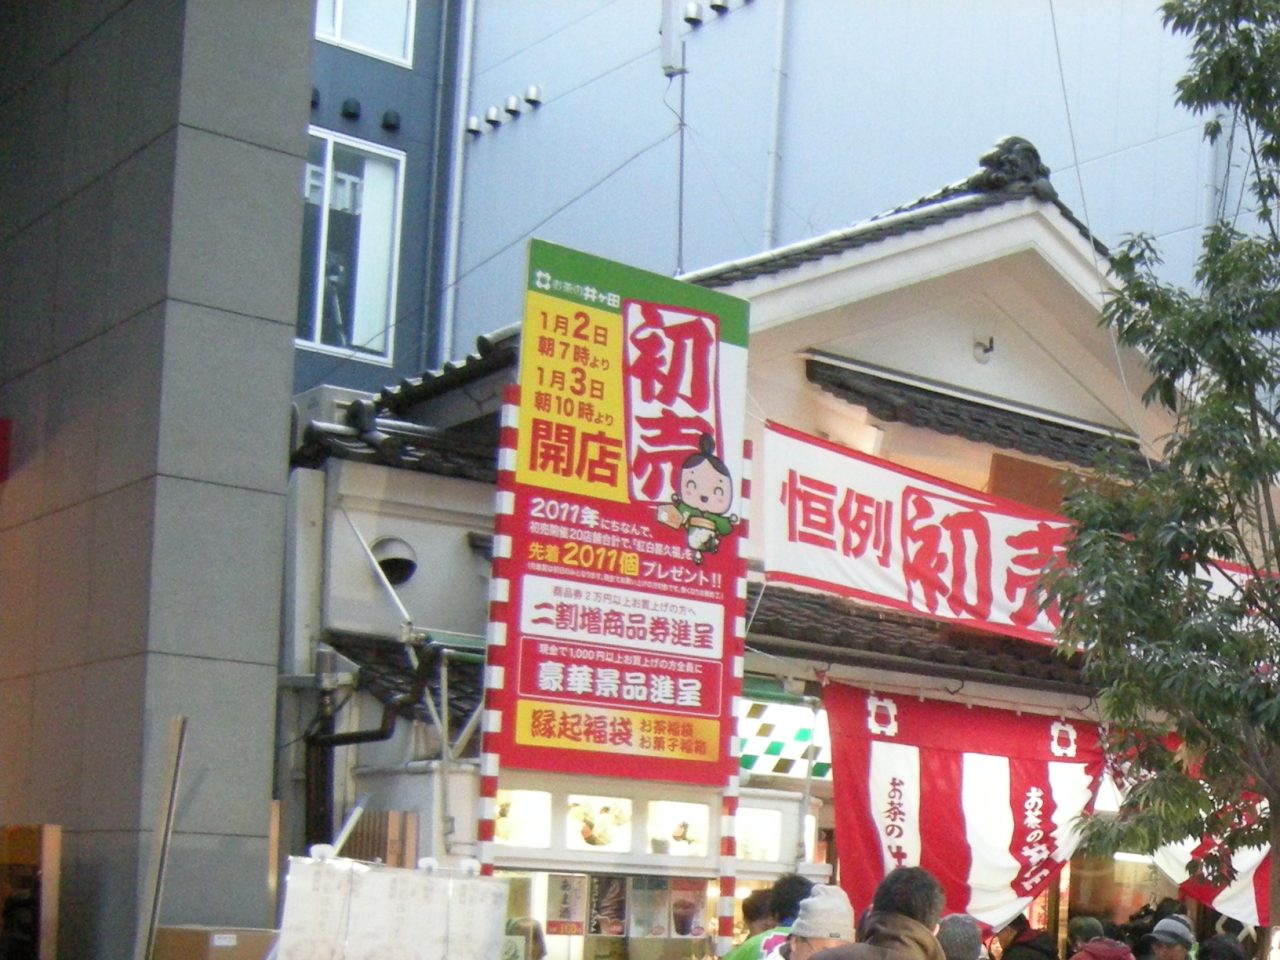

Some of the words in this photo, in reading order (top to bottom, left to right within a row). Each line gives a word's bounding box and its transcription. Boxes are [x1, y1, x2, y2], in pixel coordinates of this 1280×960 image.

[541, 311, 608, 346] 1月2日
[538, 335, 610, 371] 朝7時より
[537, 366, 604, 400] 1月3日
[628, 303, 717, 501] 初売
[534, 391, 614, 426] 朝10時より
[529, 417, 623, 488] 開店
[531, 602, 714, 649] 二割増商品券進呈
[538, 661, 702, 707] 豪華景品進呈
[531, 709, 633, 747] 縁起福袋
